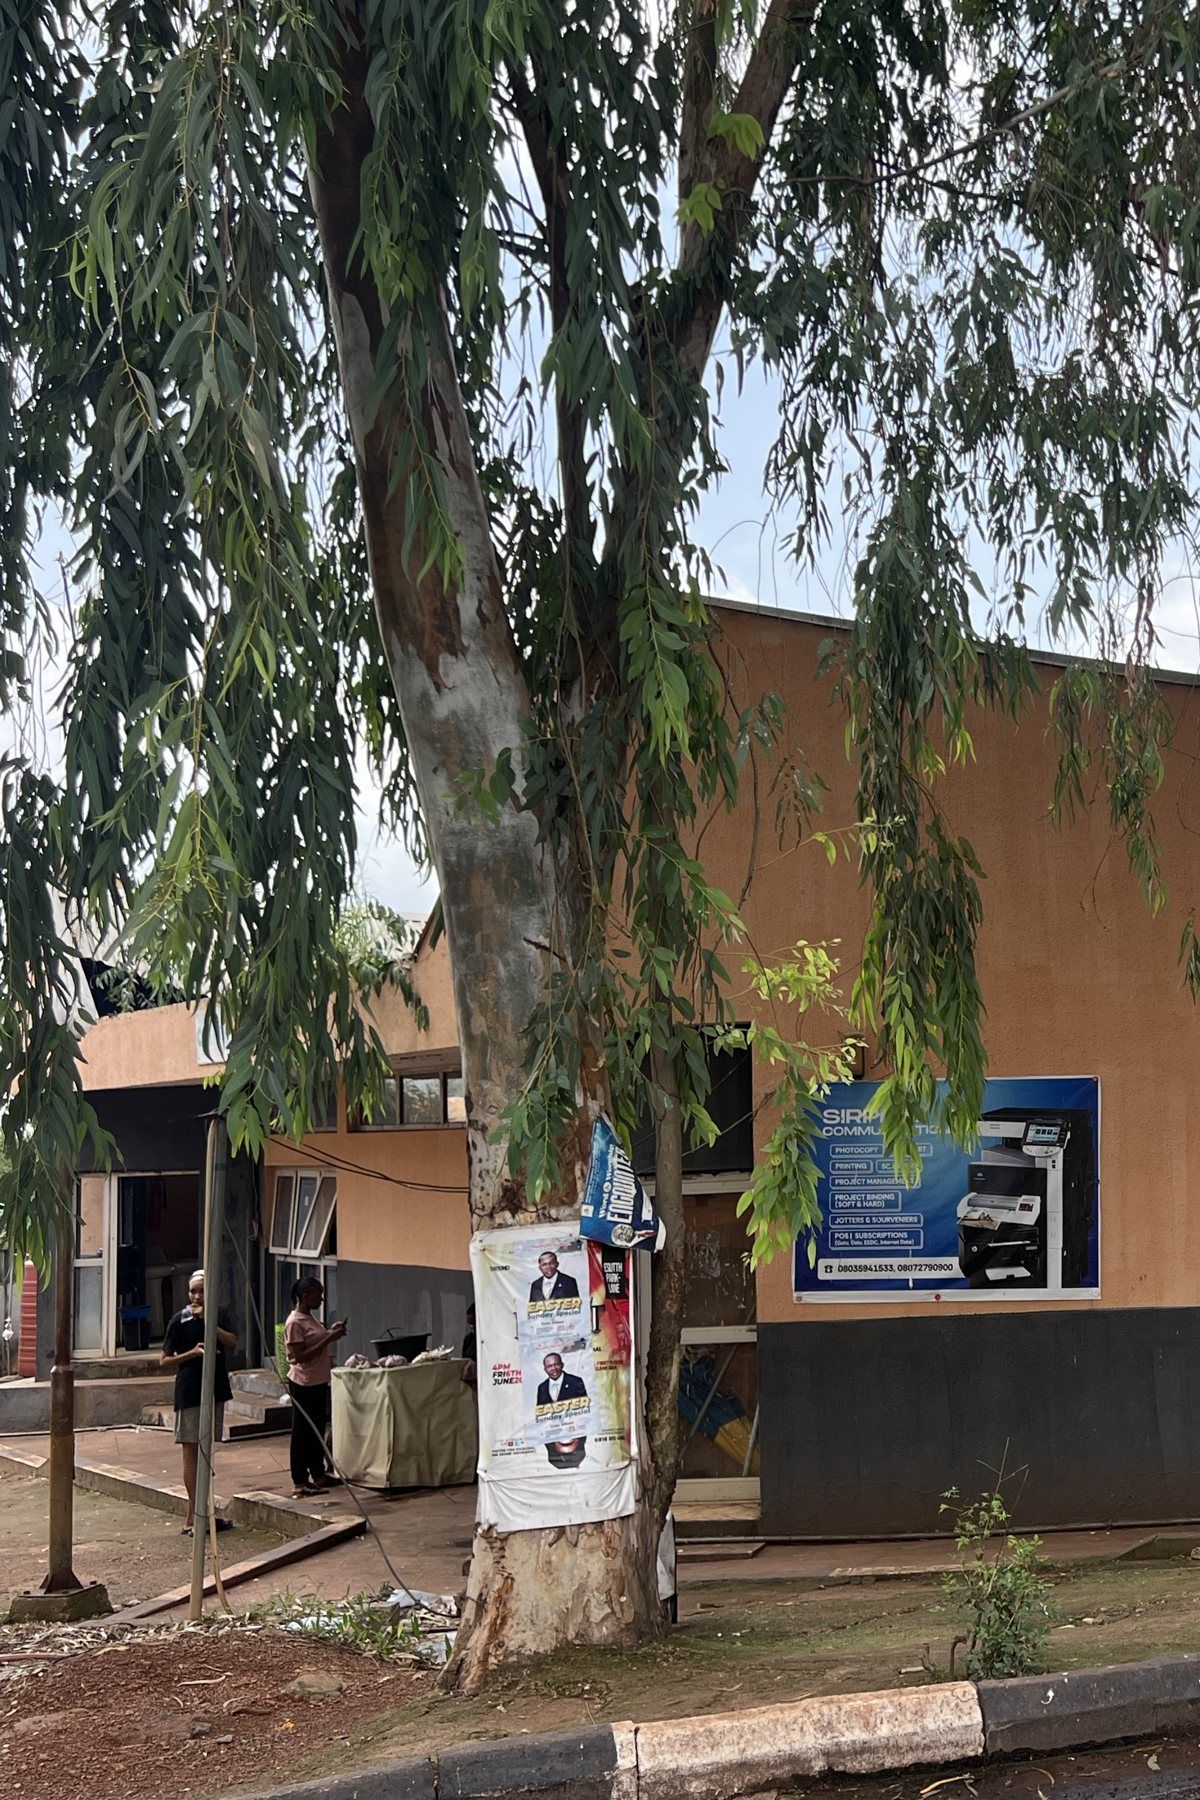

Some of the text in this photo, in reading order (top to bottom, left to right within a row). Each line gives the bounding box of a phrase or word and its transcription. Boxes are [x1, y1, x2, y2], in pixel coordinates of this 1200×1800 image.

[834, 1146, 879, 1154] PHOTOCOPY
[834, 1162, 867, 1170] PRINTING
[834, 1178, 866, 1186] PROJECT
[834, 1193, 866, 1201] PROJECT
[863, 1200, 885, 1208] HARD)
[854, 1231, 908, 1239] SUBSCRIPTIONS
[897, 1263, 953, 1272] 08072790900
[527, 1297, 582, 1313] EASTER
[527, 1309, 581, 1320] Sunday Special
[492, 1363, 511, 1371] 4PM
[535, 1397, 591, 1417] EASTER
[535, 1407, 591, 1423] Sunday Special
